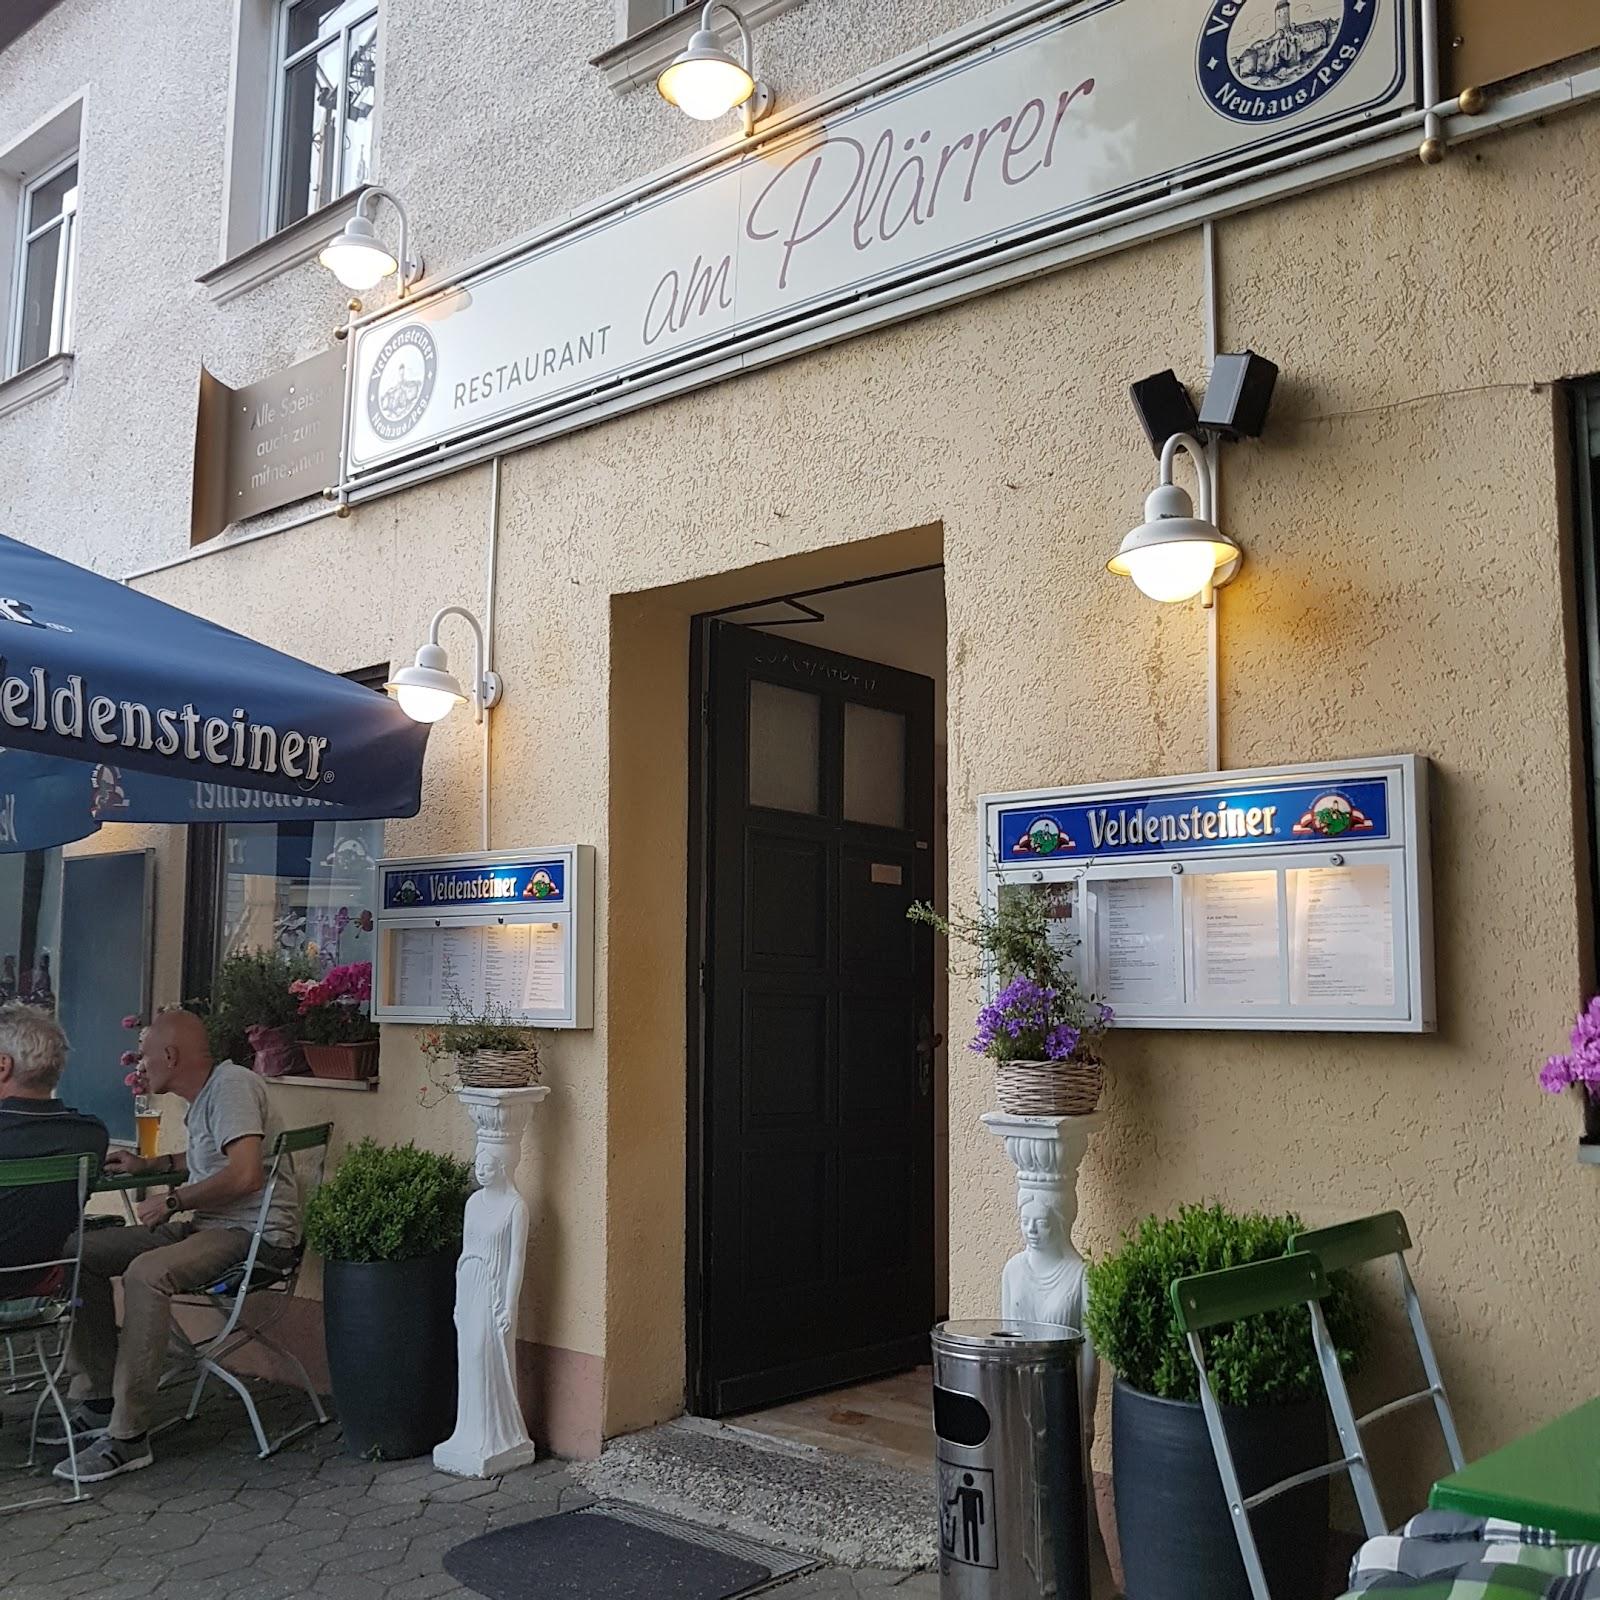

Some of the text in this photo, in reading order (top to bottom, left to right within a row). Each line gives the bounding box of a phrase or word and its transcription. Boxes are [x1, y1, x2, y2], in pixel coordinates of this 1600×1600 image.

[1214, 37, 1360, 116] Neuhaus/Peg.
[453, 77, 1095, 410] RESTAURANT am Plärrer
[249, 402, 277, 430] Alle
[0, 667, 329, 781] eldensteiner
[1086, 800, 1277, 849] Veldensteiner
[429, 872, 517, 902] Veldensteiner
